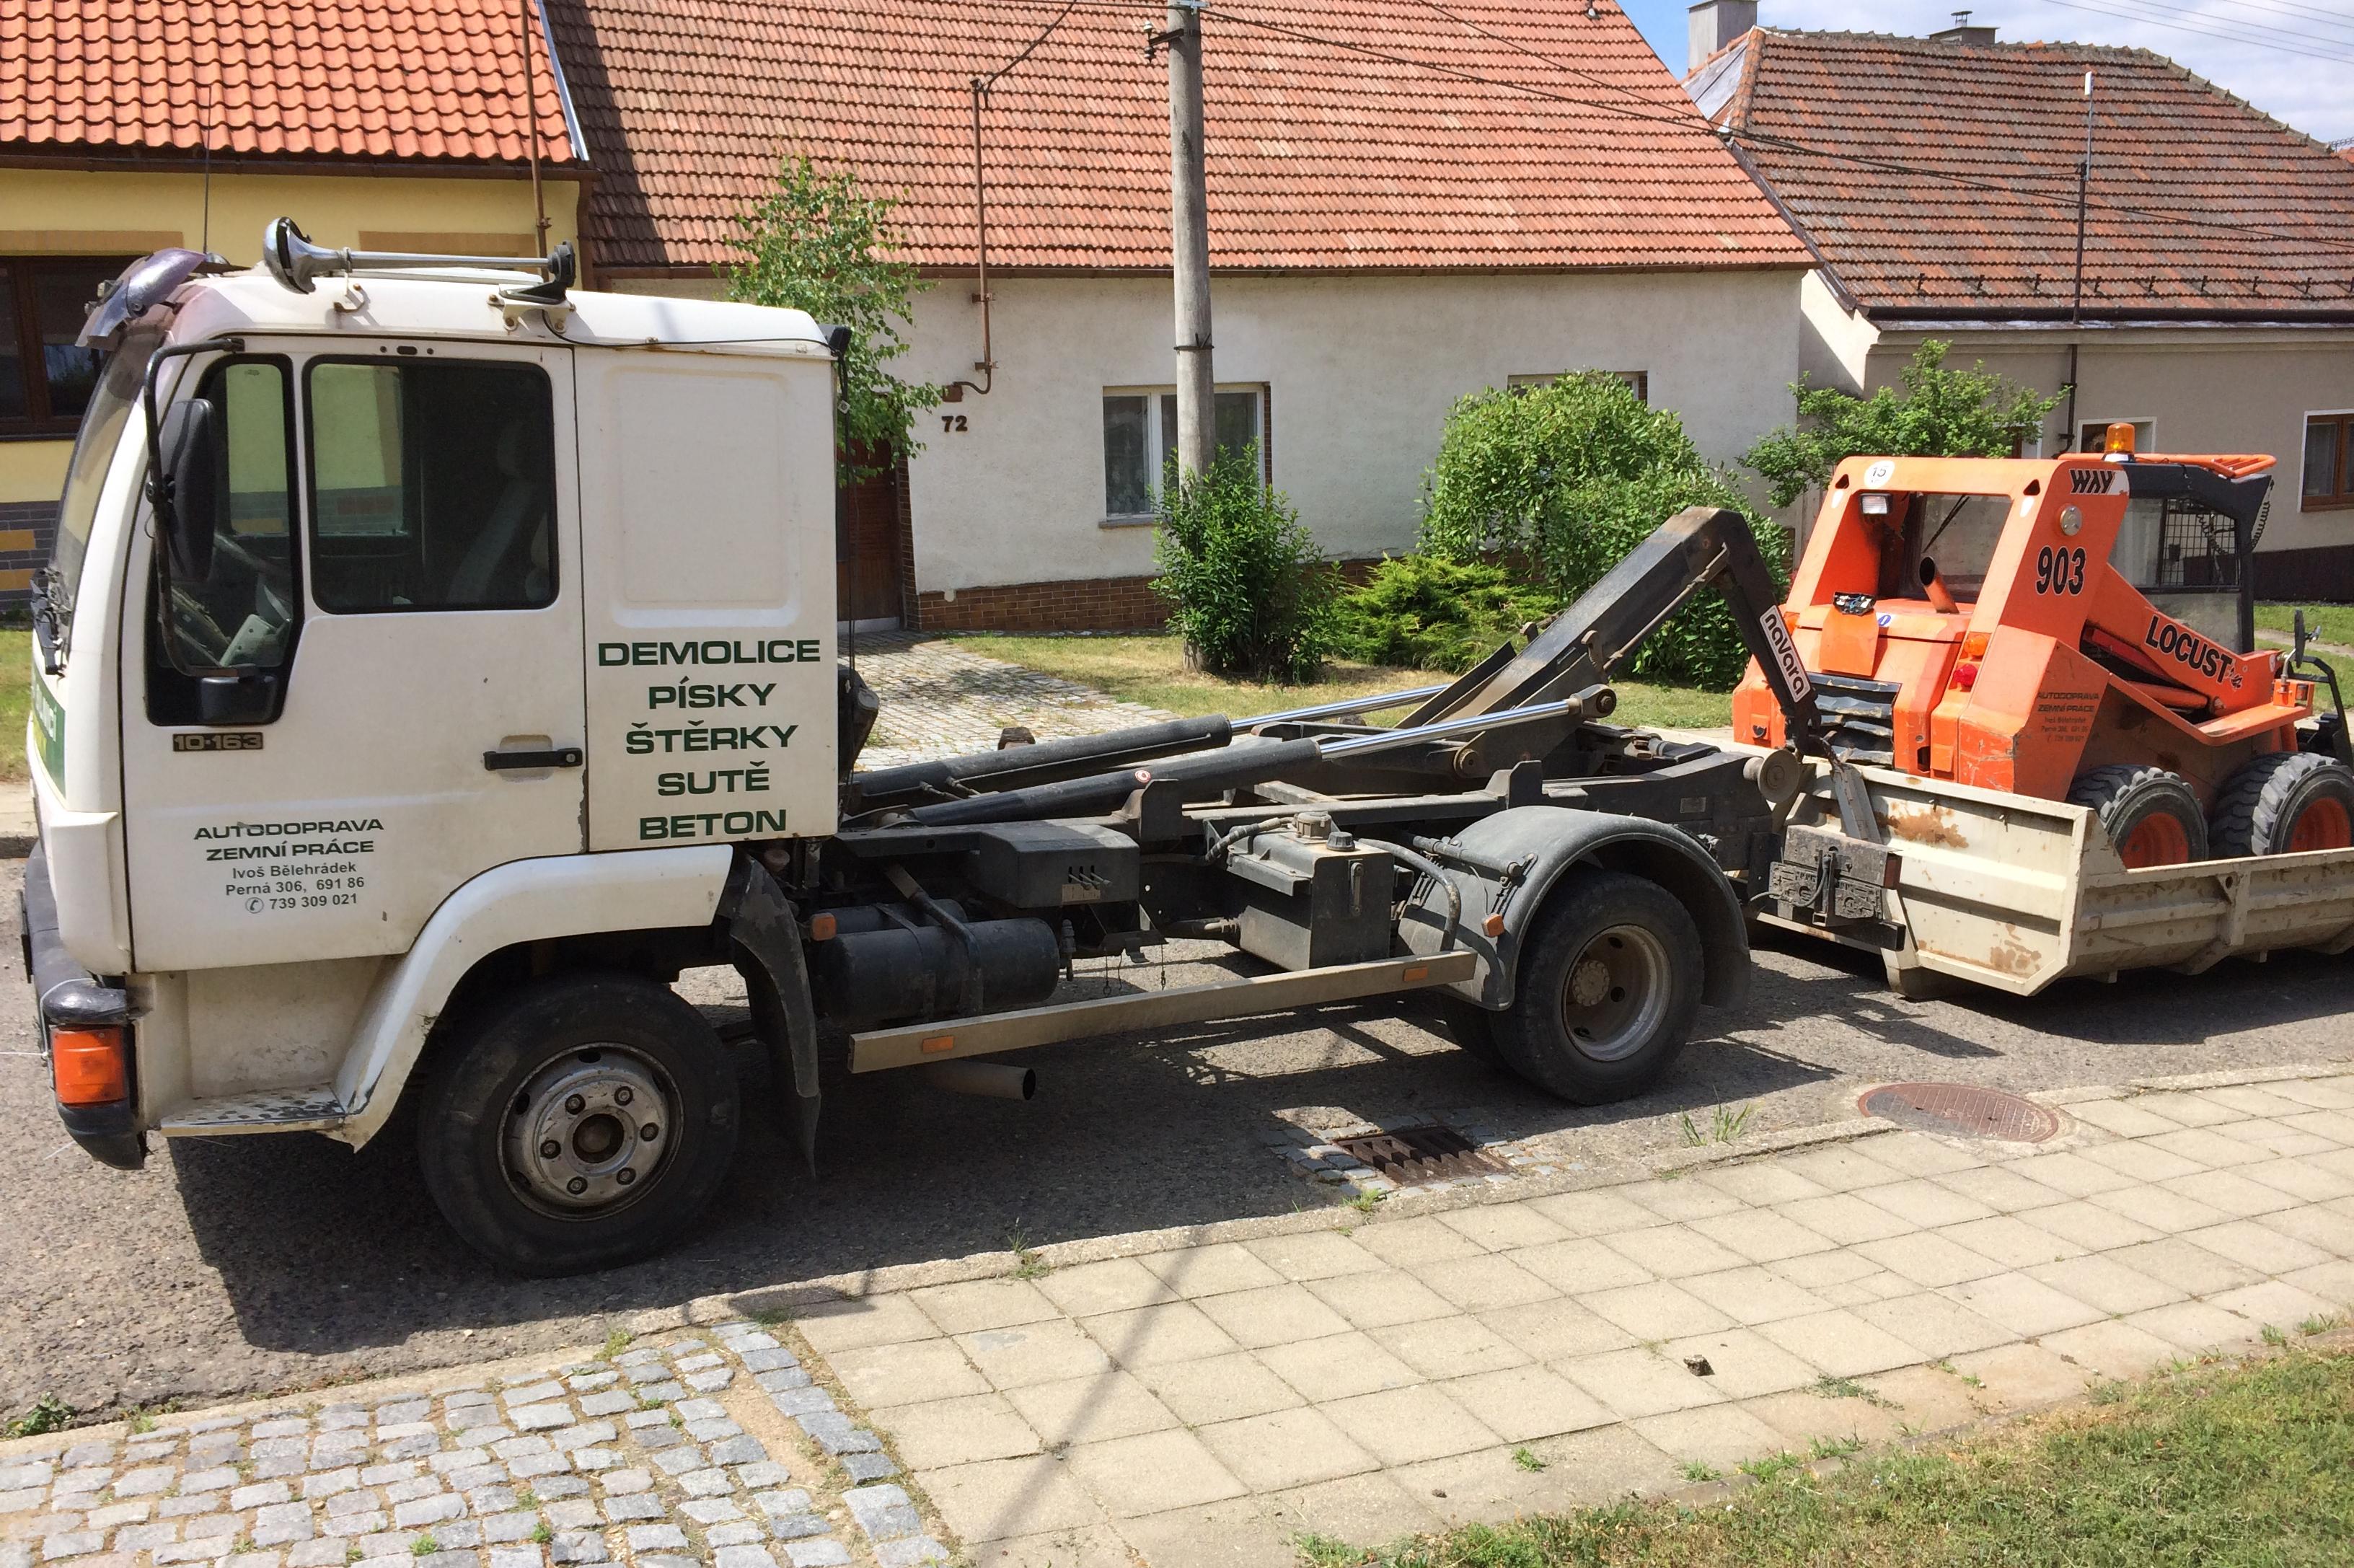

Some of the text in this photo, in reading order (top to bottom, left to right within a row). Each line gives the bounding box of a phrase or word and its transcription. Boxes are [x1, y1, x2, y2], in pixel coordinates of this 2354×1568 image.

[941, 415, 968, 432] 72
[2069, 469, 2115, 494] WAY
[2035, 545, 2087, 596] 903
[598, 639, 821, 666] DEMOLICE
[1765, 613, 1804, 695] navara
[2145, 615, 2233, 684] LOCUST
[649, 675, 777, 709] PÍSKY
[626, 720, 799, 754] ŠTĚRKY
[658, 760, 770, 796] SUTĚ
[193, 819, 384, 840] AUTODOPRAVA
[640, 809, 787, 840] BETON
[206, 839, 374, 861] ZEMNÍ PRÁCE
[232, 861, 357, 879] Ivoš Bělehrádek
[226, 876, 365, 896] Perná 306, 691 86
[270, 893, 358, 910] 739 309 021
